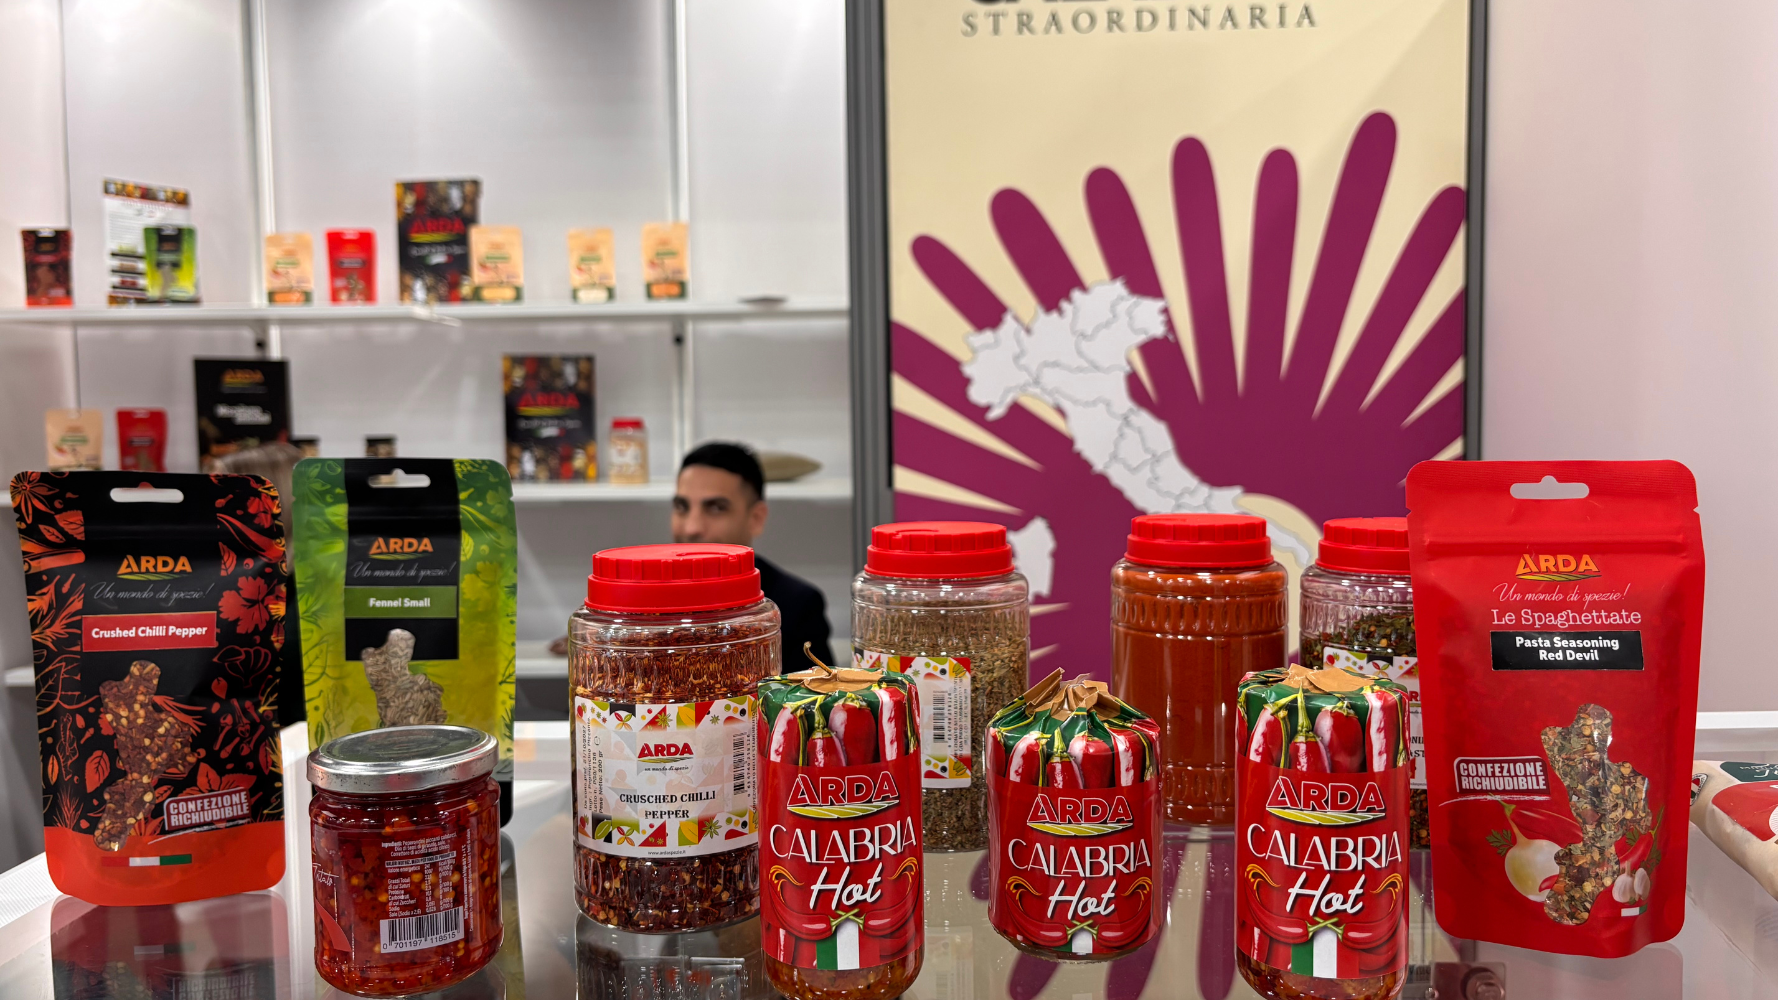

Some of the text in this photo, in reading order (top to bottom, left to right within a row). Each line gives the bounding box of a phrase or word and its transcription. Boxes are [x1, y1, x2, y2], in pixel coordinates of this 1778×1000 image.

[961, 3, 1319, 37] STRAORDINARIA
[368, 537, 434, 555] ARDA
[117, 555, 192, 575] ARDA
[373, 562, 405, 577] mondo
[407, 563, 419, 576] di
[1515, 554, 1600, 576] ARDA
[90, 582, 215, 607] Un mondo di spezie!
[368, 598, 431, 608] Fennel Small
[1492, 582, 1631, 610] Un mondo di spezie!
[1491, 608, 1642, 628] Le Spaghettate
[91, 625, 208, 640] Crushed Chilli Pepper
[1515, 636, 1620, 650] Pasta Seasoning
[1539, 649, 1600, 661] Red Devil
[637, 742, 694, 758] ARDA
[1459, 761, 1543, 778] CONFEZIONE
[787, 771, 900, 806] ARDA
[1266, 776, 1385, 812] ARDA
[1461, 775, 1547, 791] RICHIUDIBILE
[169, 791, 248, 814] CONFEZIONE
[619, 790, 716, 804] CRUSCHED CHILLI
[170, 803, 250, 827] RICHIUDIBILE
[644, 809, 690, 819] PEPPER
[1027, 794, 1133, 824] ARDA
[769, 815, 917, 864] CALABRIA
[1247, 823, 1402, 871] CALABRIA
[1008, 838, 1151, 878] CALABRIA
[809, 862, 883, 910] Hot
[1285, 871, 1366, 917] Hot
[1047, 879, 1117, 921] Hot
[394, 940, 422, 949] 701197
[430, 932, 456, 943] 118515
